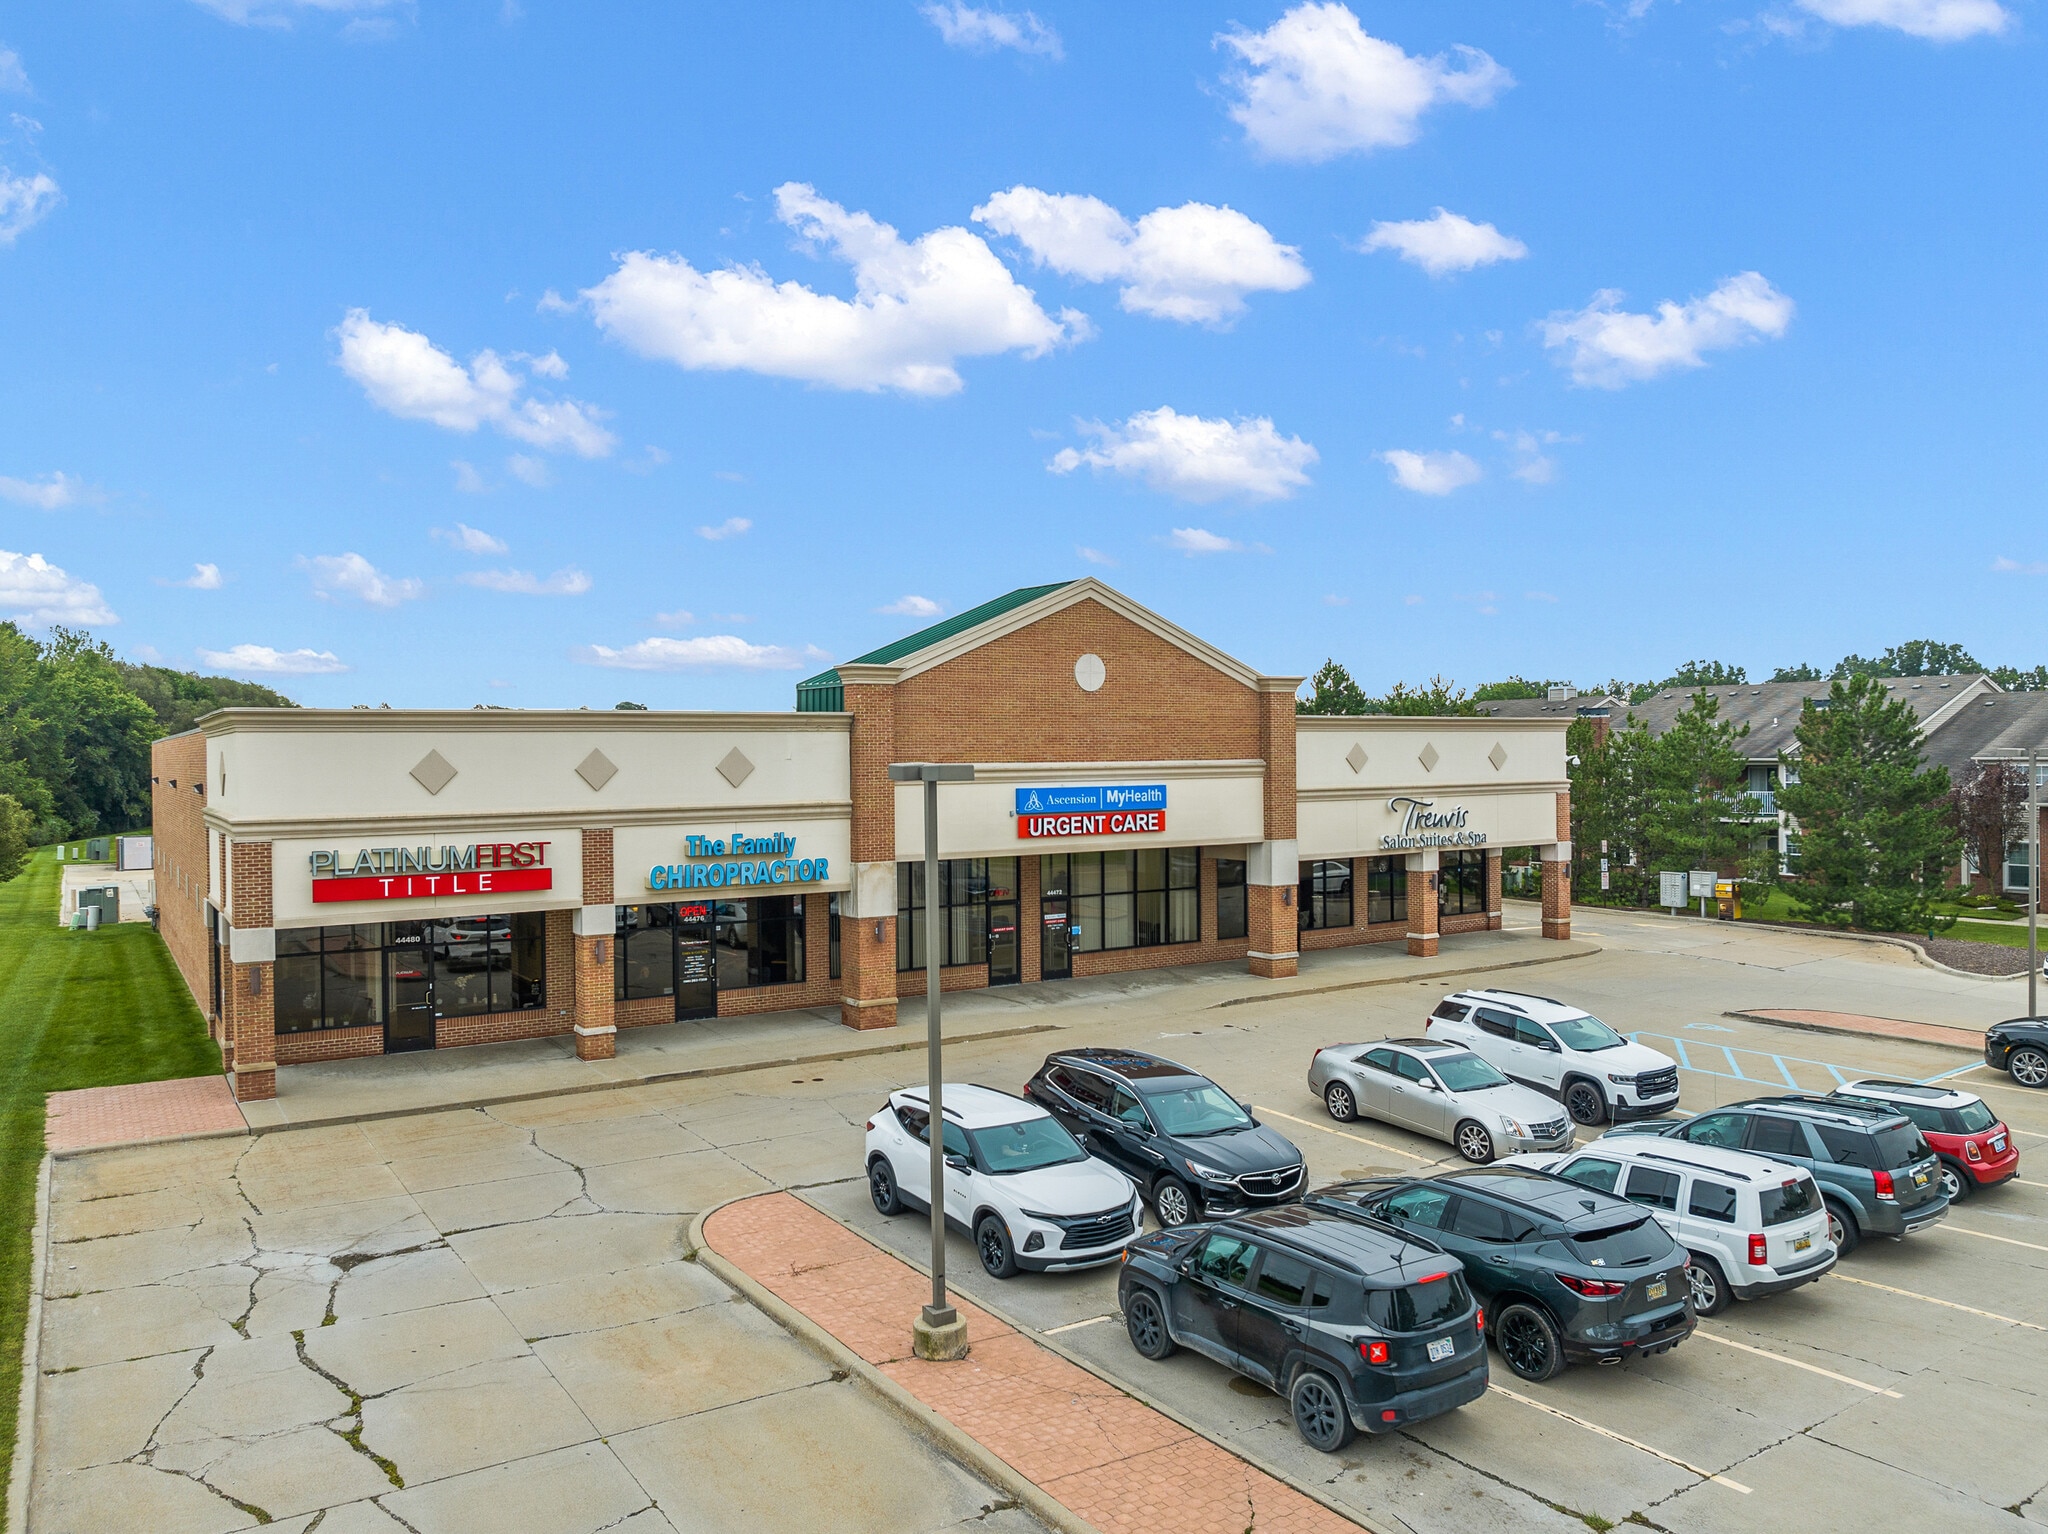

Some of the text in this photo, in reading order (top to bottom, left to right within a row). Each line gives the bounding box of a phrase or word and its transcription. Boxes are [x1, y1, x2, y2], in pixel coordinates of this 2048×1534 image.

[1046, 789, 1162, 807] Ascension MyHealth
[1029, 813, 1159, 837] URGENT CARE
[1389, 797, 1469, 836] Treuvis
[685, 832, 797, 858] The Family
[1382, 830, 1487, 850] Salon Suites & Spa
[379, 873, 492, 897] TITLE
[649, 857, 829, 890] CHIROPRACTOR
[679, 905, 707, 917] OPEN
